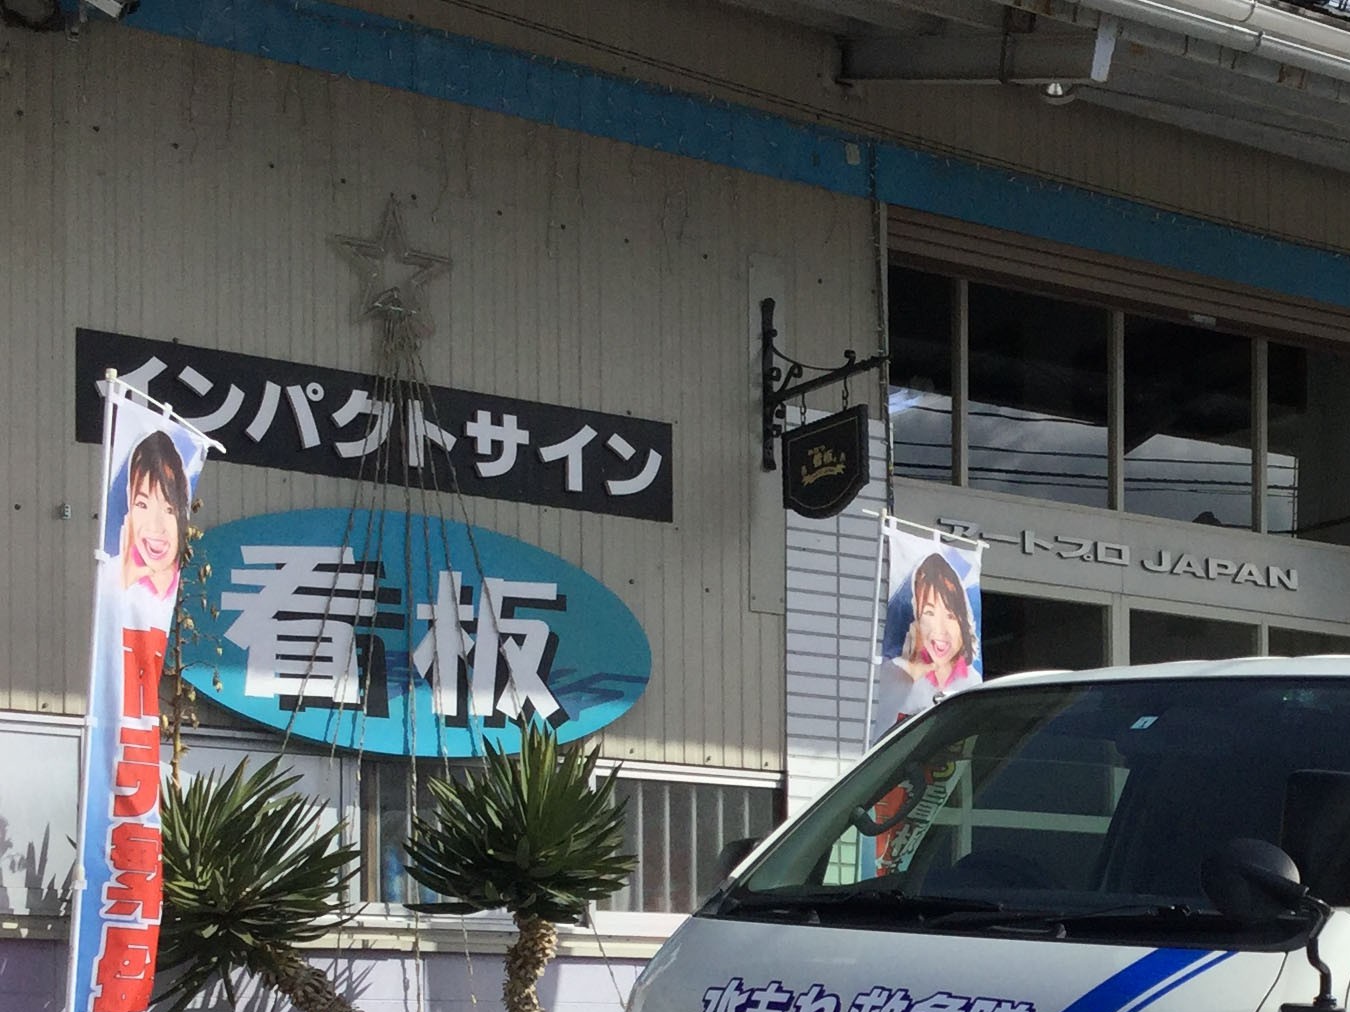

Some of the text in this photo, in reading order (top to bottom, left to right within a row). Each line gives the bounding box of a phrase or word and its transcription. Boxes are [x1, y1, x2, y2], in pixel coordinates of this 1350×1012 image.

[95, 355, 662, 496] インパクトサイン
[937, 517, 1299, 591] アートプロ JAPAN
[220, 544, 562, 721] 看板
